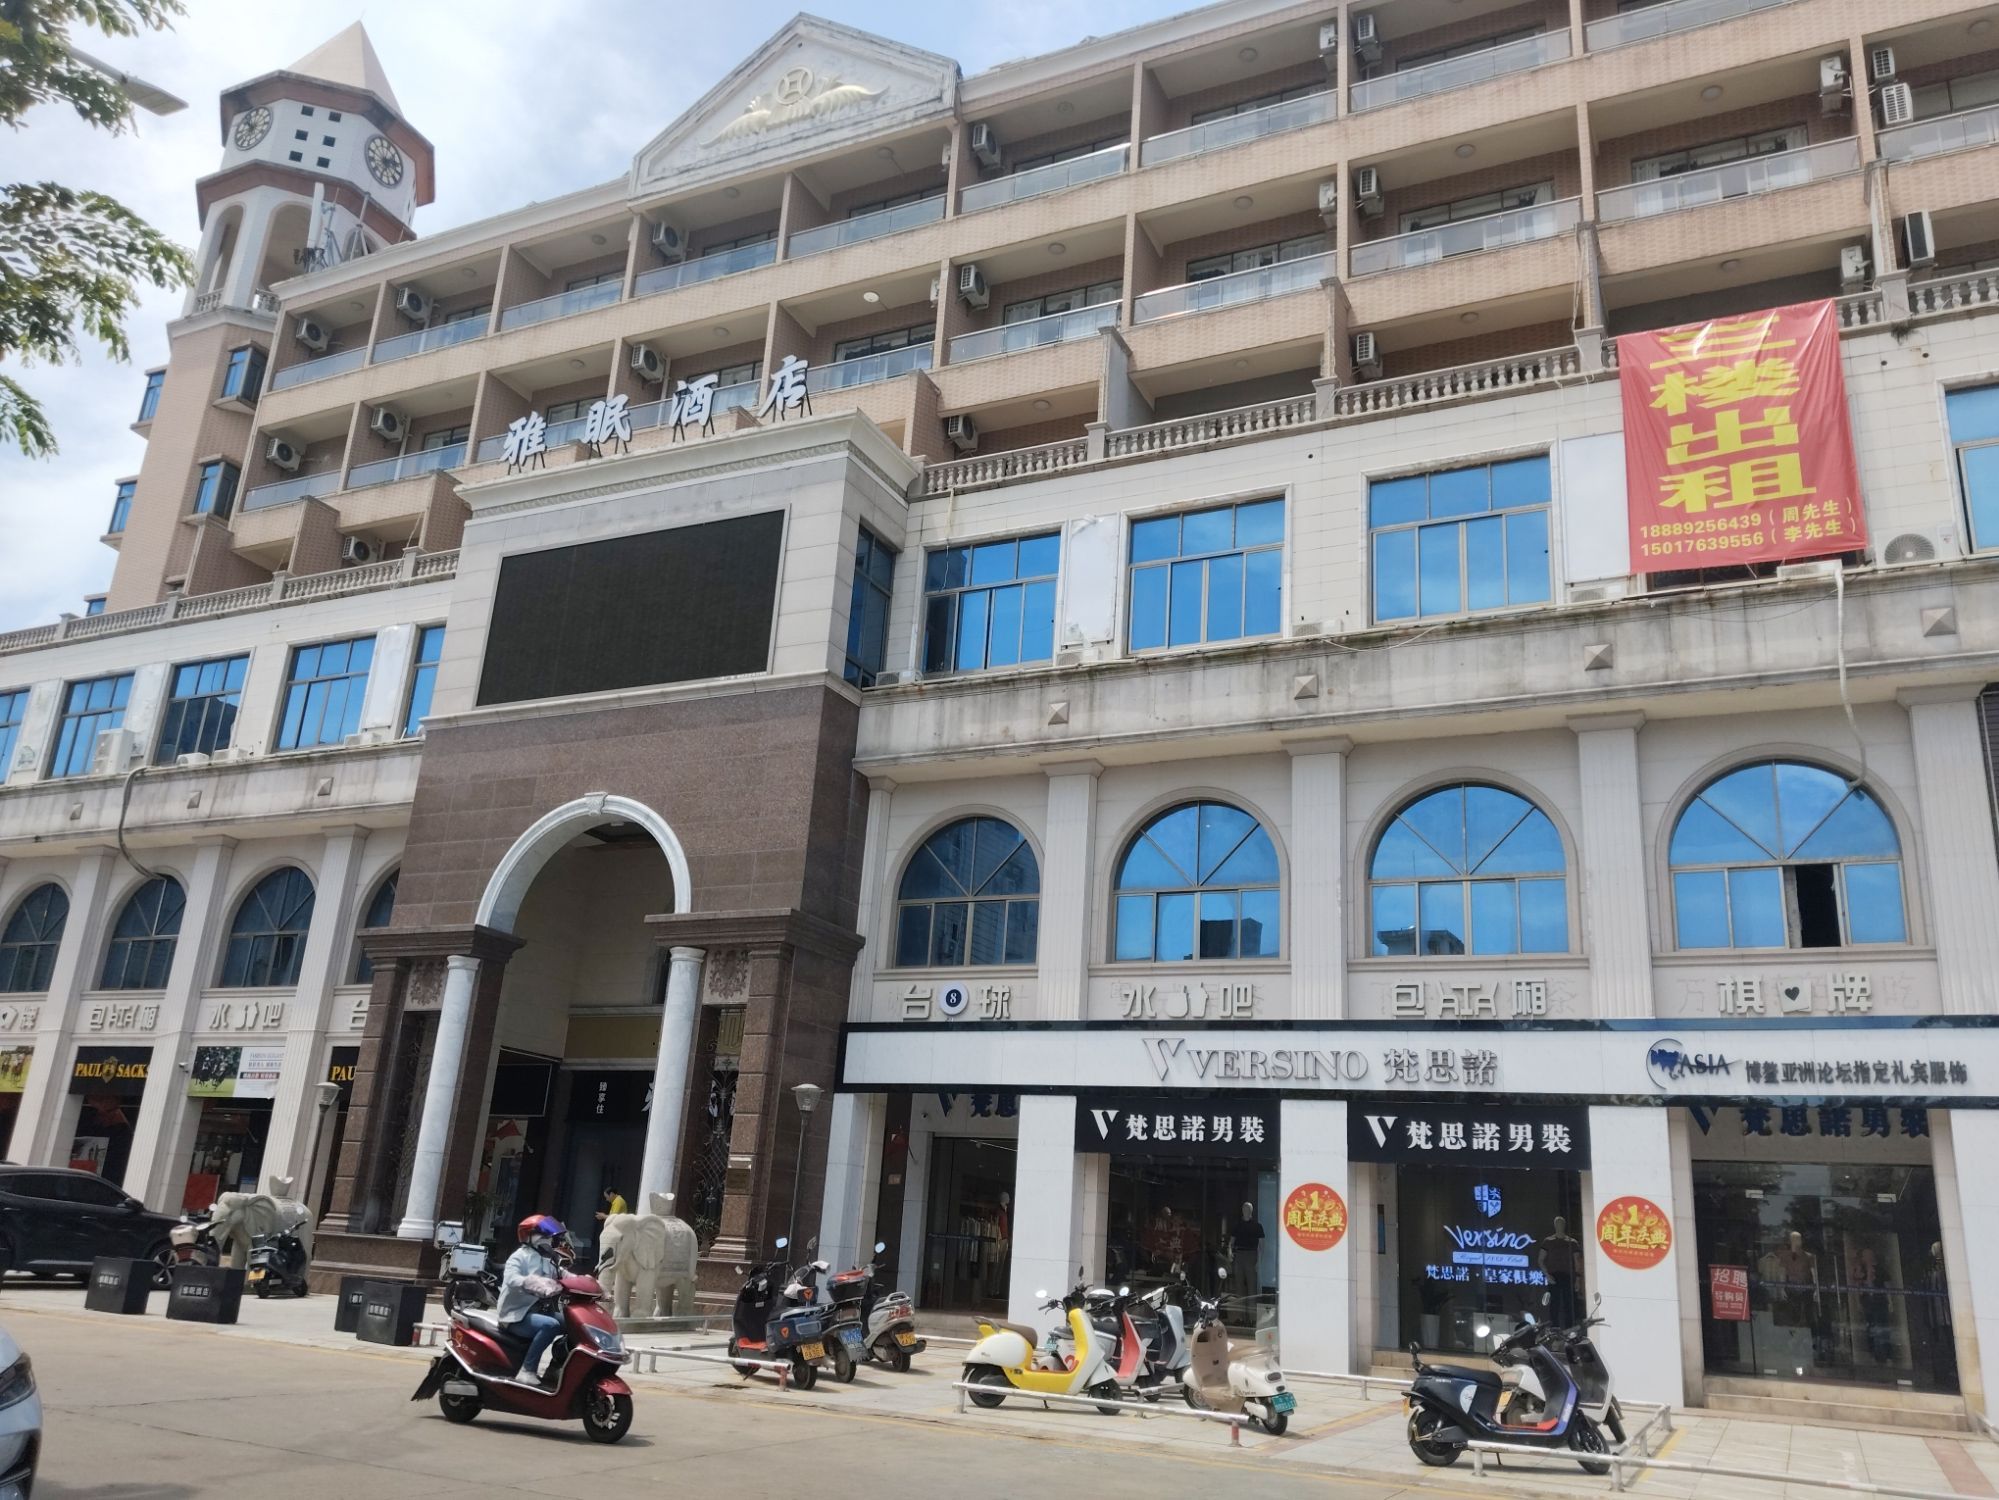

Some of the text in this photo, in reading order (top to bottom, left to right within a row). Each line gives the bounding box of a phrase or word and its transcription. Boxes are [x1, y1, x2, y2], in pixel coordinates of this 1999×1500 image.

[501, 355, 809, 466] 雅眠酒店
[1649, 315, 1817, 513] 三楼出租
[1640, 513, 1762, 539] 18889256439
[1640, 531, 1764, 557] 15017639556
[75, 1063, 102, 1077] PAUL
[1186, 1049, 1368, 1081] VERSINO
[1384, 1048, 1498, 1085] 梵思諾
[1681, 1053, 1731, 1076] ASIA
[1126, 1114, 1265, 1143] 梵思諾男裝
[1406, 1121, 1572, 1153] 梵思諾男裝
[1286, 1209, 1345, 1232] 周年庆典
[1443, 1225, 1536, 1250] Versino
[1600, 1224, 1670, 1249] 周年庆典
[1425, 1264, 1549, 1286] 梵思諾·皇家俱樂
[1712, 1267, 1748, 1288] 招聘
